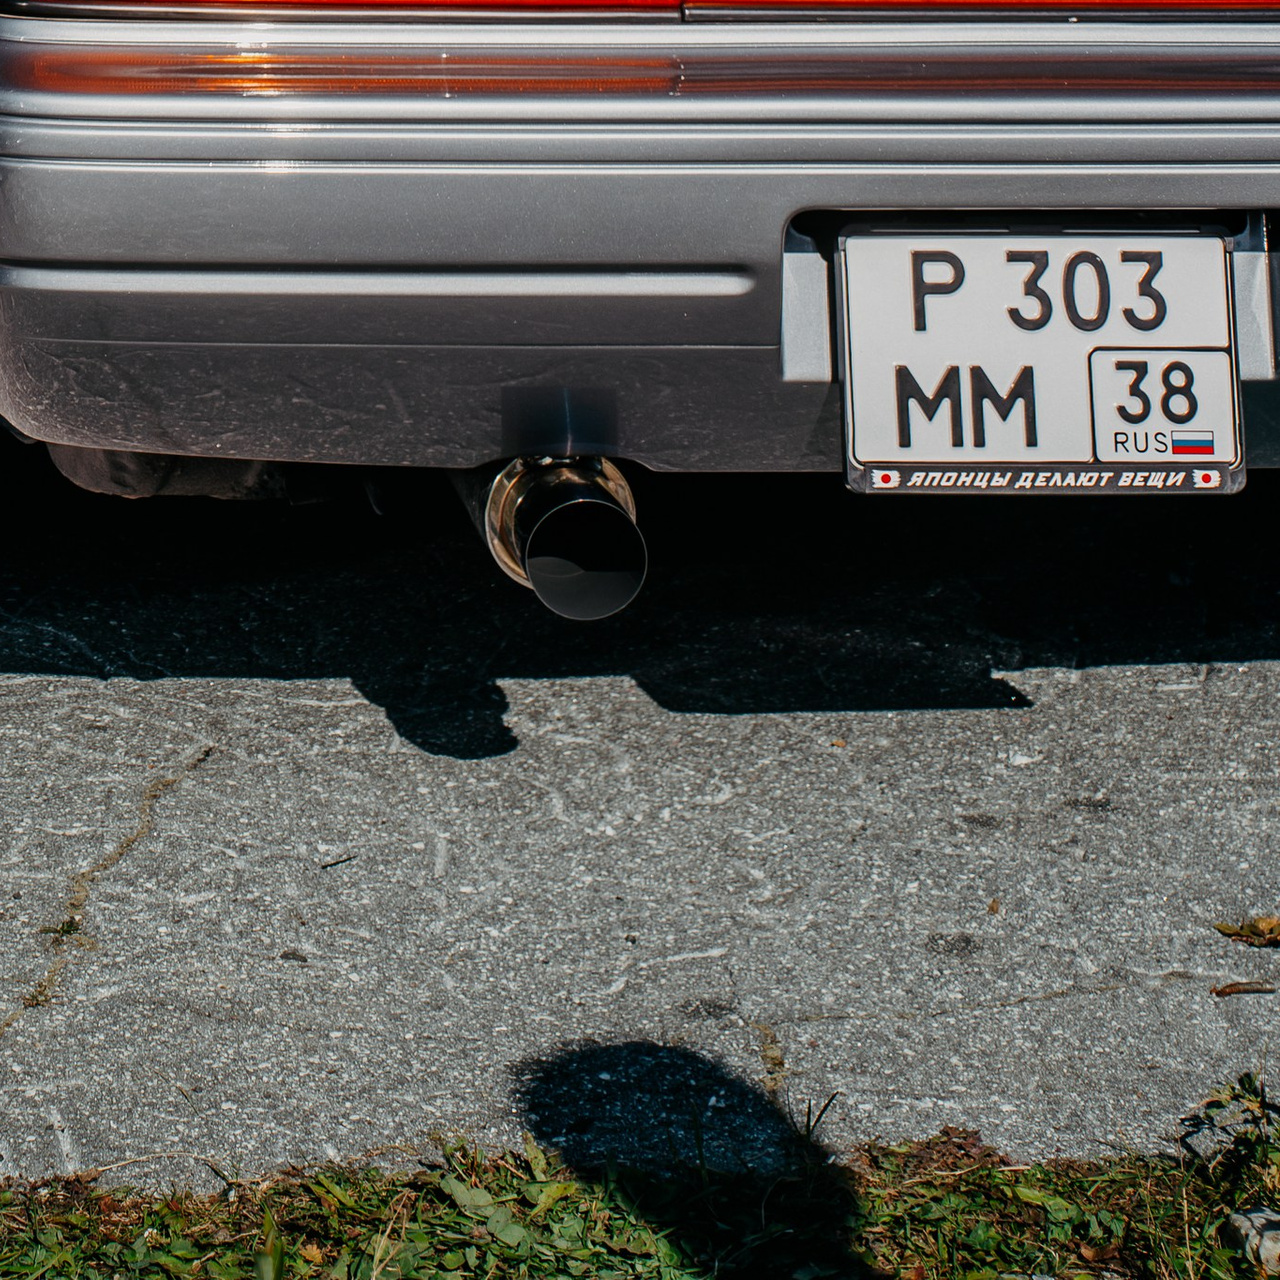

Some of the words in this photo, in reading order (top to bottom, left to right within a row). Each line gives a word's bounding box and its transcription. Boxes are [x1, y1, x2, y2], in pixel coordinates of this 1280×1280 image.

[1005, 249, 1168, 332] 303
[1114, 359, 1199, 425] 38
[1113, 430, 1169, 454] RUS
[906, 471, 1012, 490] ЯПОНЦЫ
[1013, 471, 1115, 489] ДЕЛАЮТ
[1117, 471, 1187, 489] ВЕЩИ
